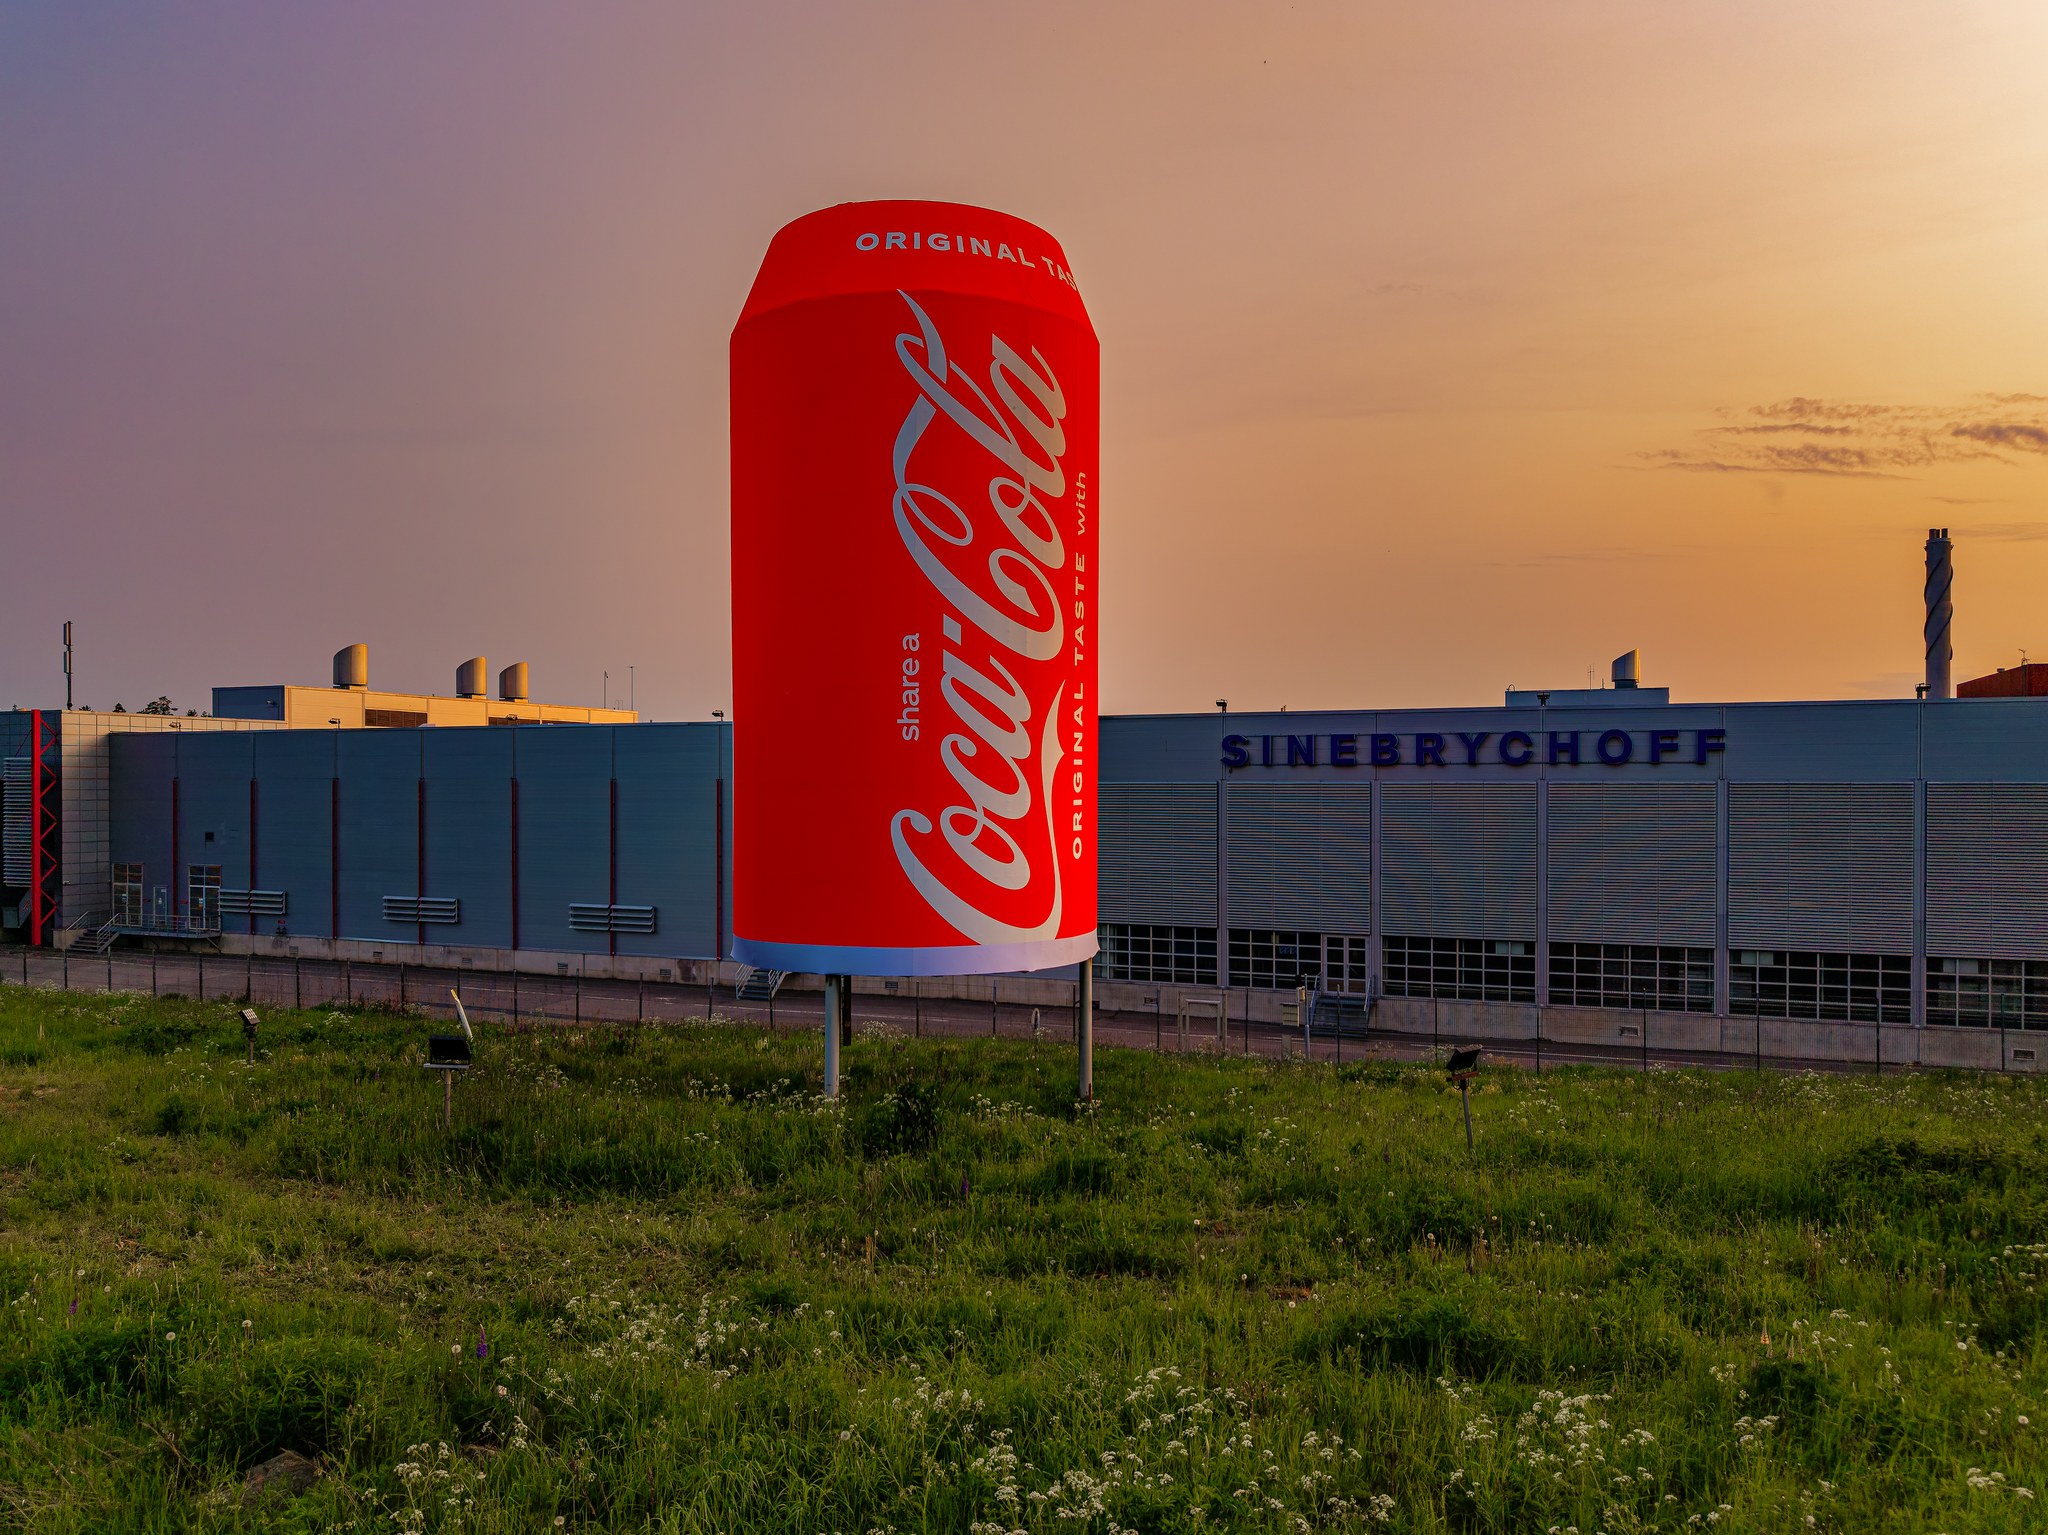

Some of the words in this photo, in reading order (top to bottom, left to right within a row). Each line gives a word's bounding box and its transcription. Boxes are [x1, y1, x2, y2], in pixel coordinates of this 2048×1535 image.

[855, 232, 1036, 268] ORIGINAL
[1076, 471, 1087, 536] with
[890, 288, 1067, 946] Coca-Cola
[902, 632, 920, 652] a
[1074, 552, 1085, 666] TASTE
[896, 657, 920, 742] share
[1072, 682, 1084, 860] ORIGINAL
[1220, 728, 1726, 768] SINEBRYCHOFF
